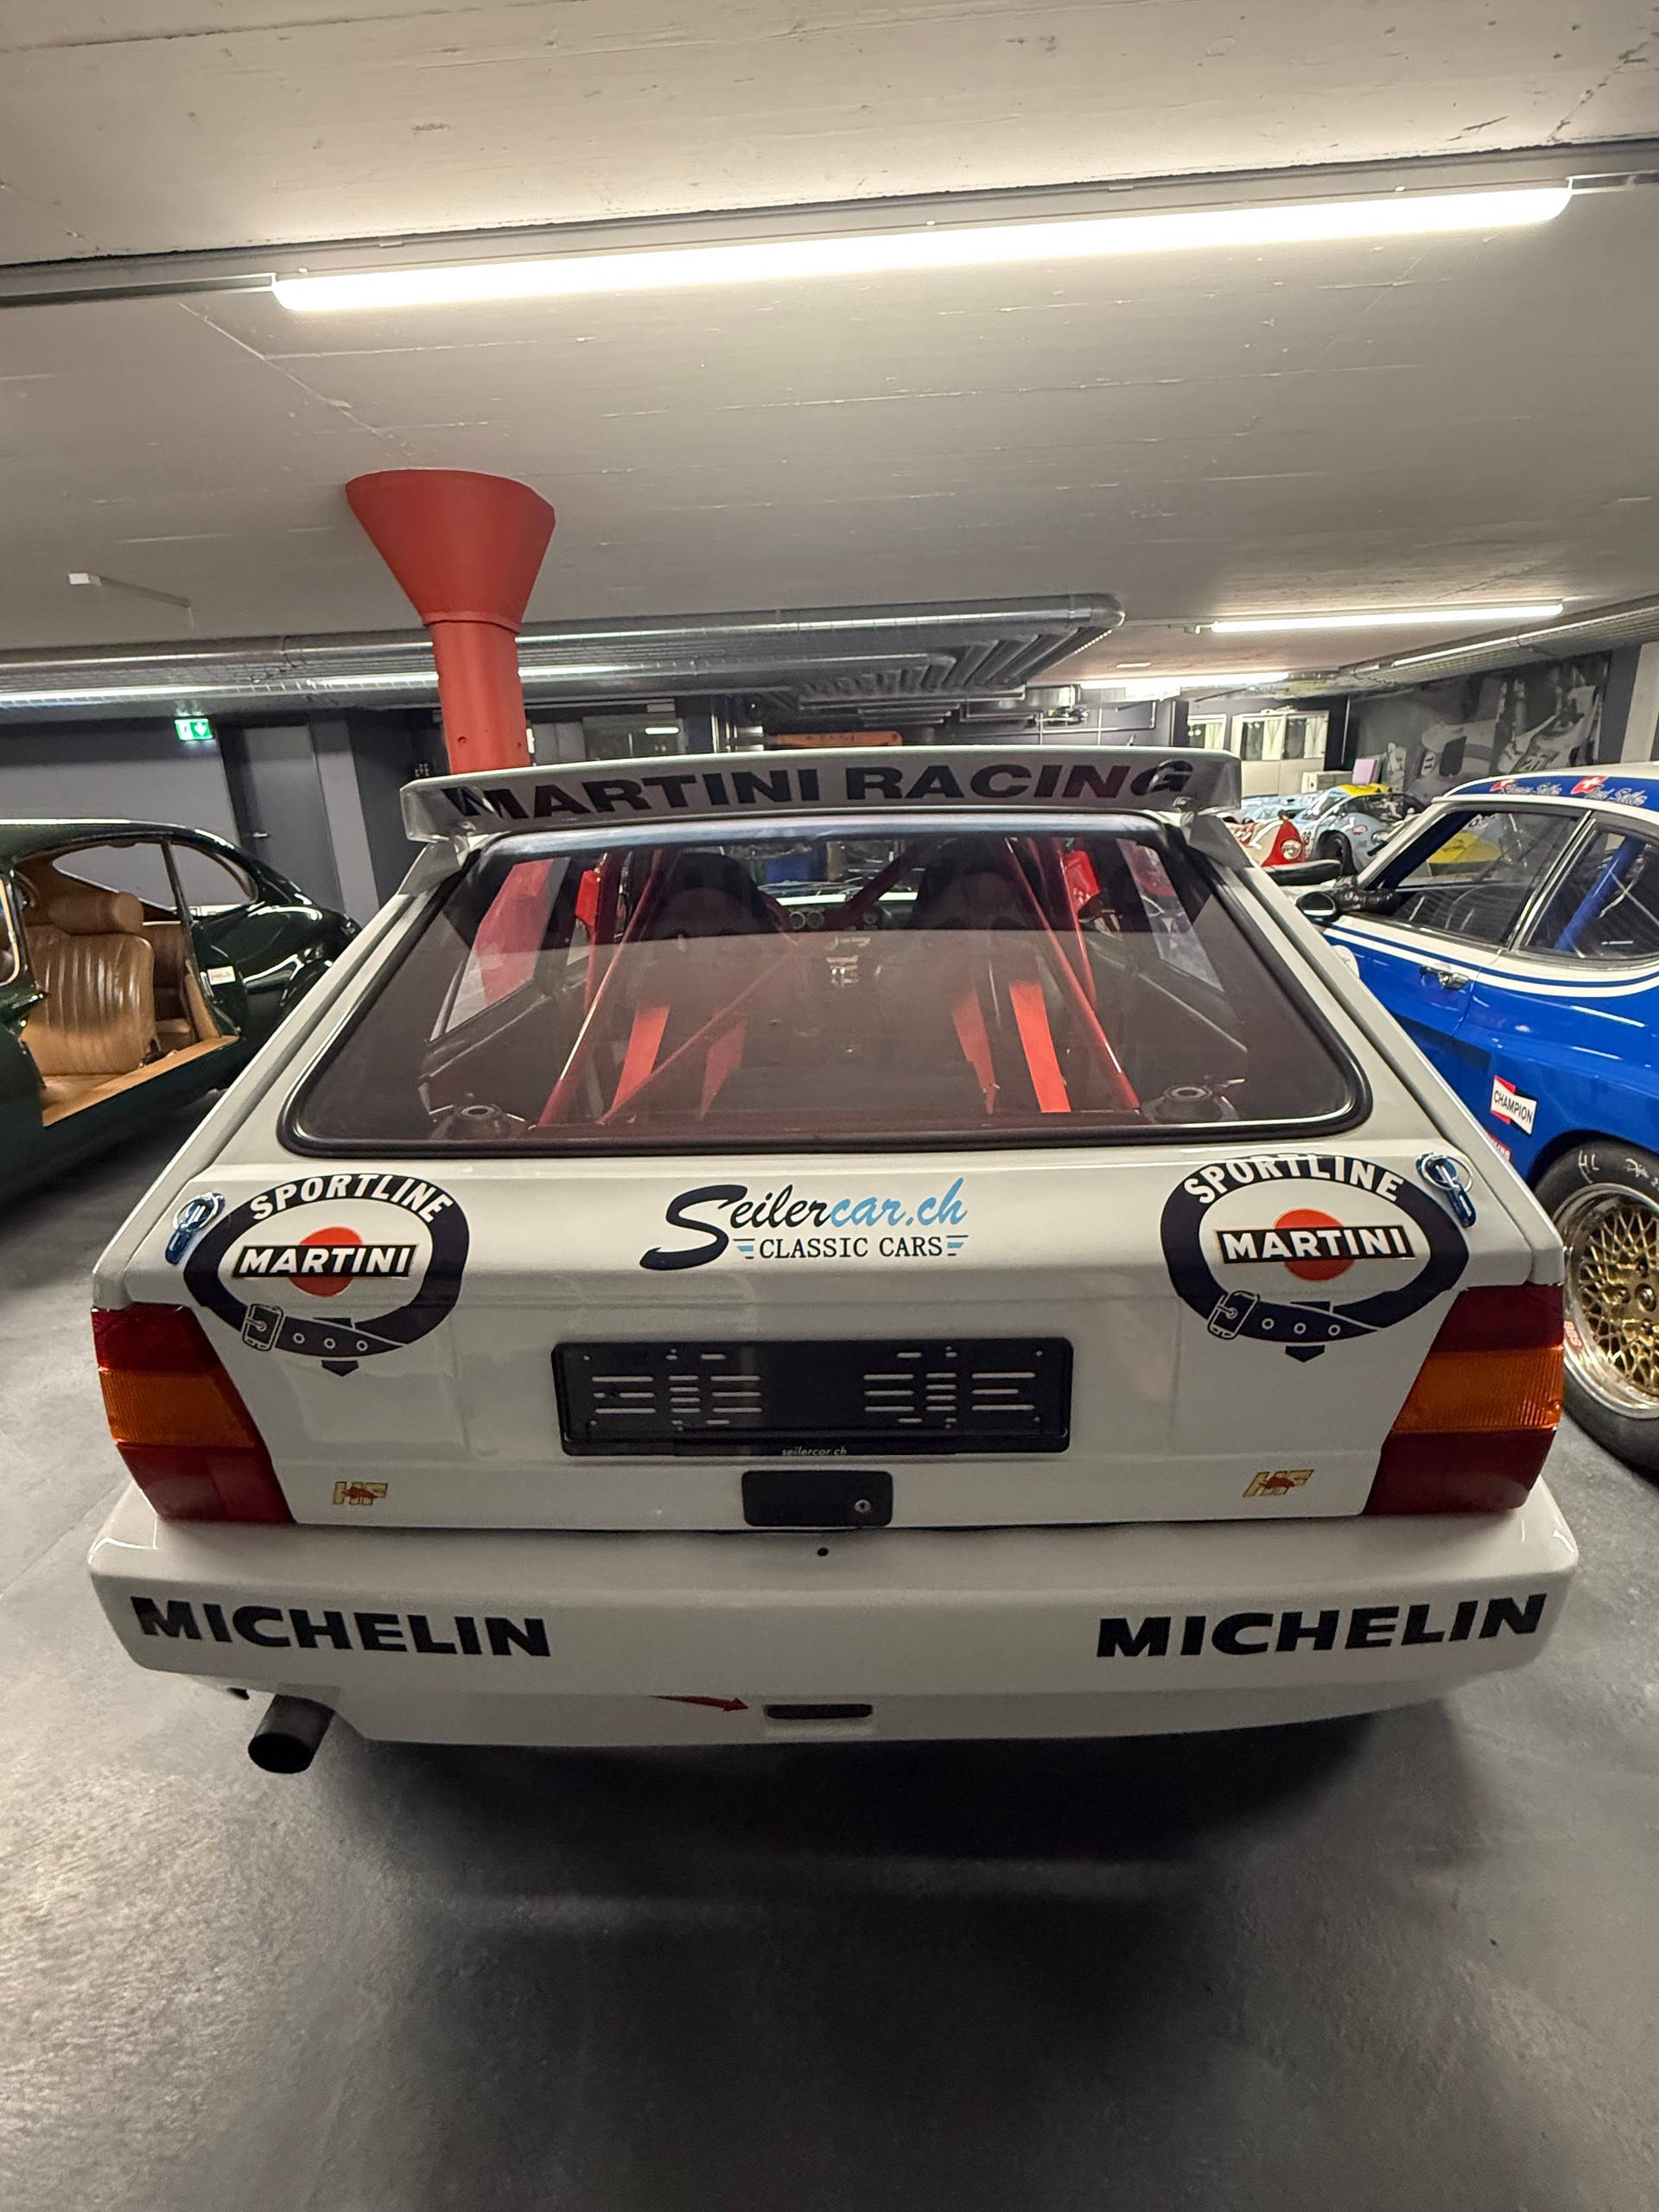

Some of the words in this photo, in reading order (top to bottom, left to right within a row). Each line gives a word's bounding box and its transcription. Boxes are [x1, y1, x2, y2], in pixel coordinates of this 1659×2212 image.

[442, 769, 820, 819] MARTINI
[845, 760, 1193, 800] RACING
[1493, 1090, 1533, 1123] CHAMPION
[250, 1173, 453, 1223] SPORTLINE
[1185, 1154, 1404, 1204] SPORTLINE
[639, 1178, 968, 1270] Seilercar.ch
[760, 1237, 868, 1258] CLASSIC
[879, 1236, 943, 1257] CARS
[1223, 1228, 1407, 1260] MARTINI
[238, 1247, 410, 1274] MARTINI
[130, 1596, 550, 1657] MICHELIN
[1097, 1593, 1547, 1656] MICHELIN
